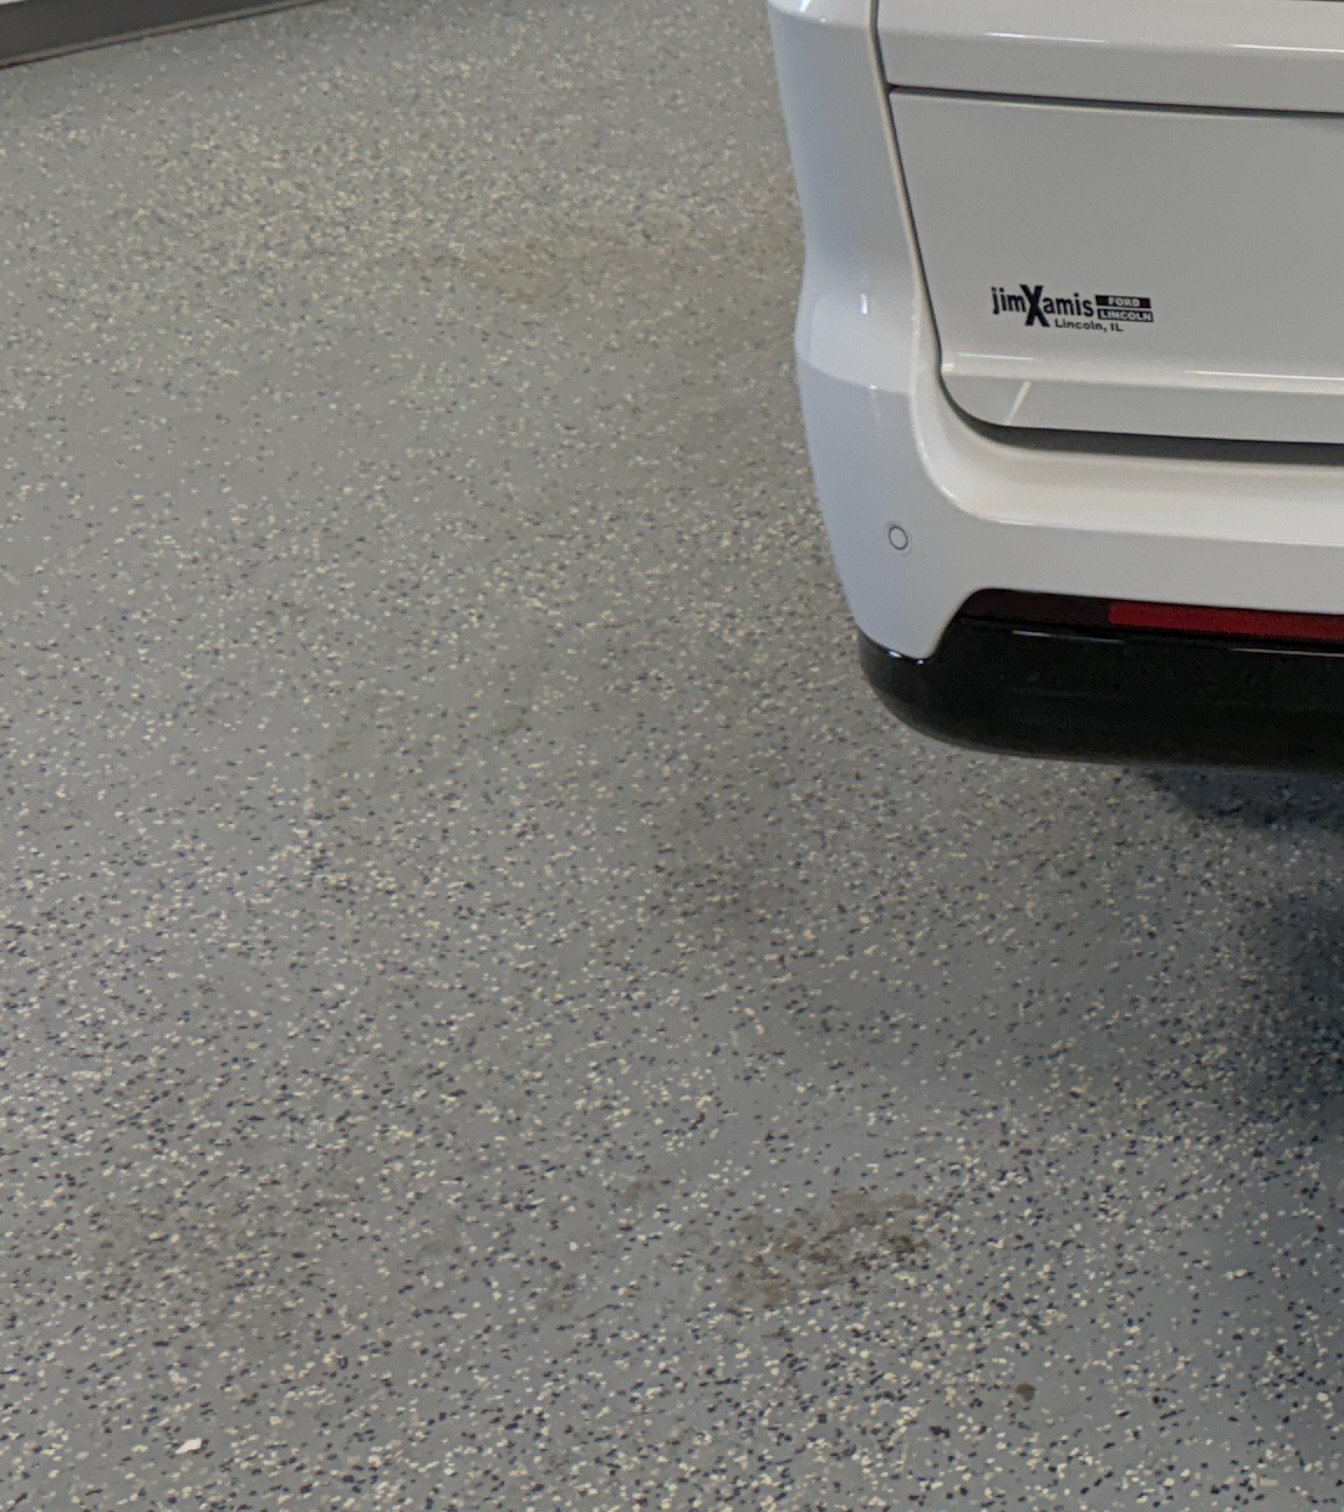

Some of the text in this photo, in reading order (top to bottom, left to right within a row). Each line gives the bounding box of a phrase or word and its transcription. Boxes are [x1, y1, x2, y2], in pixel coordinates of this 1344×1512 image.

[1108, 297, 1141, 308] FORD
[1099, 310, 1152, 321] LINCOLN
[1054, 318, 1124, 333] Lincoln, IL
